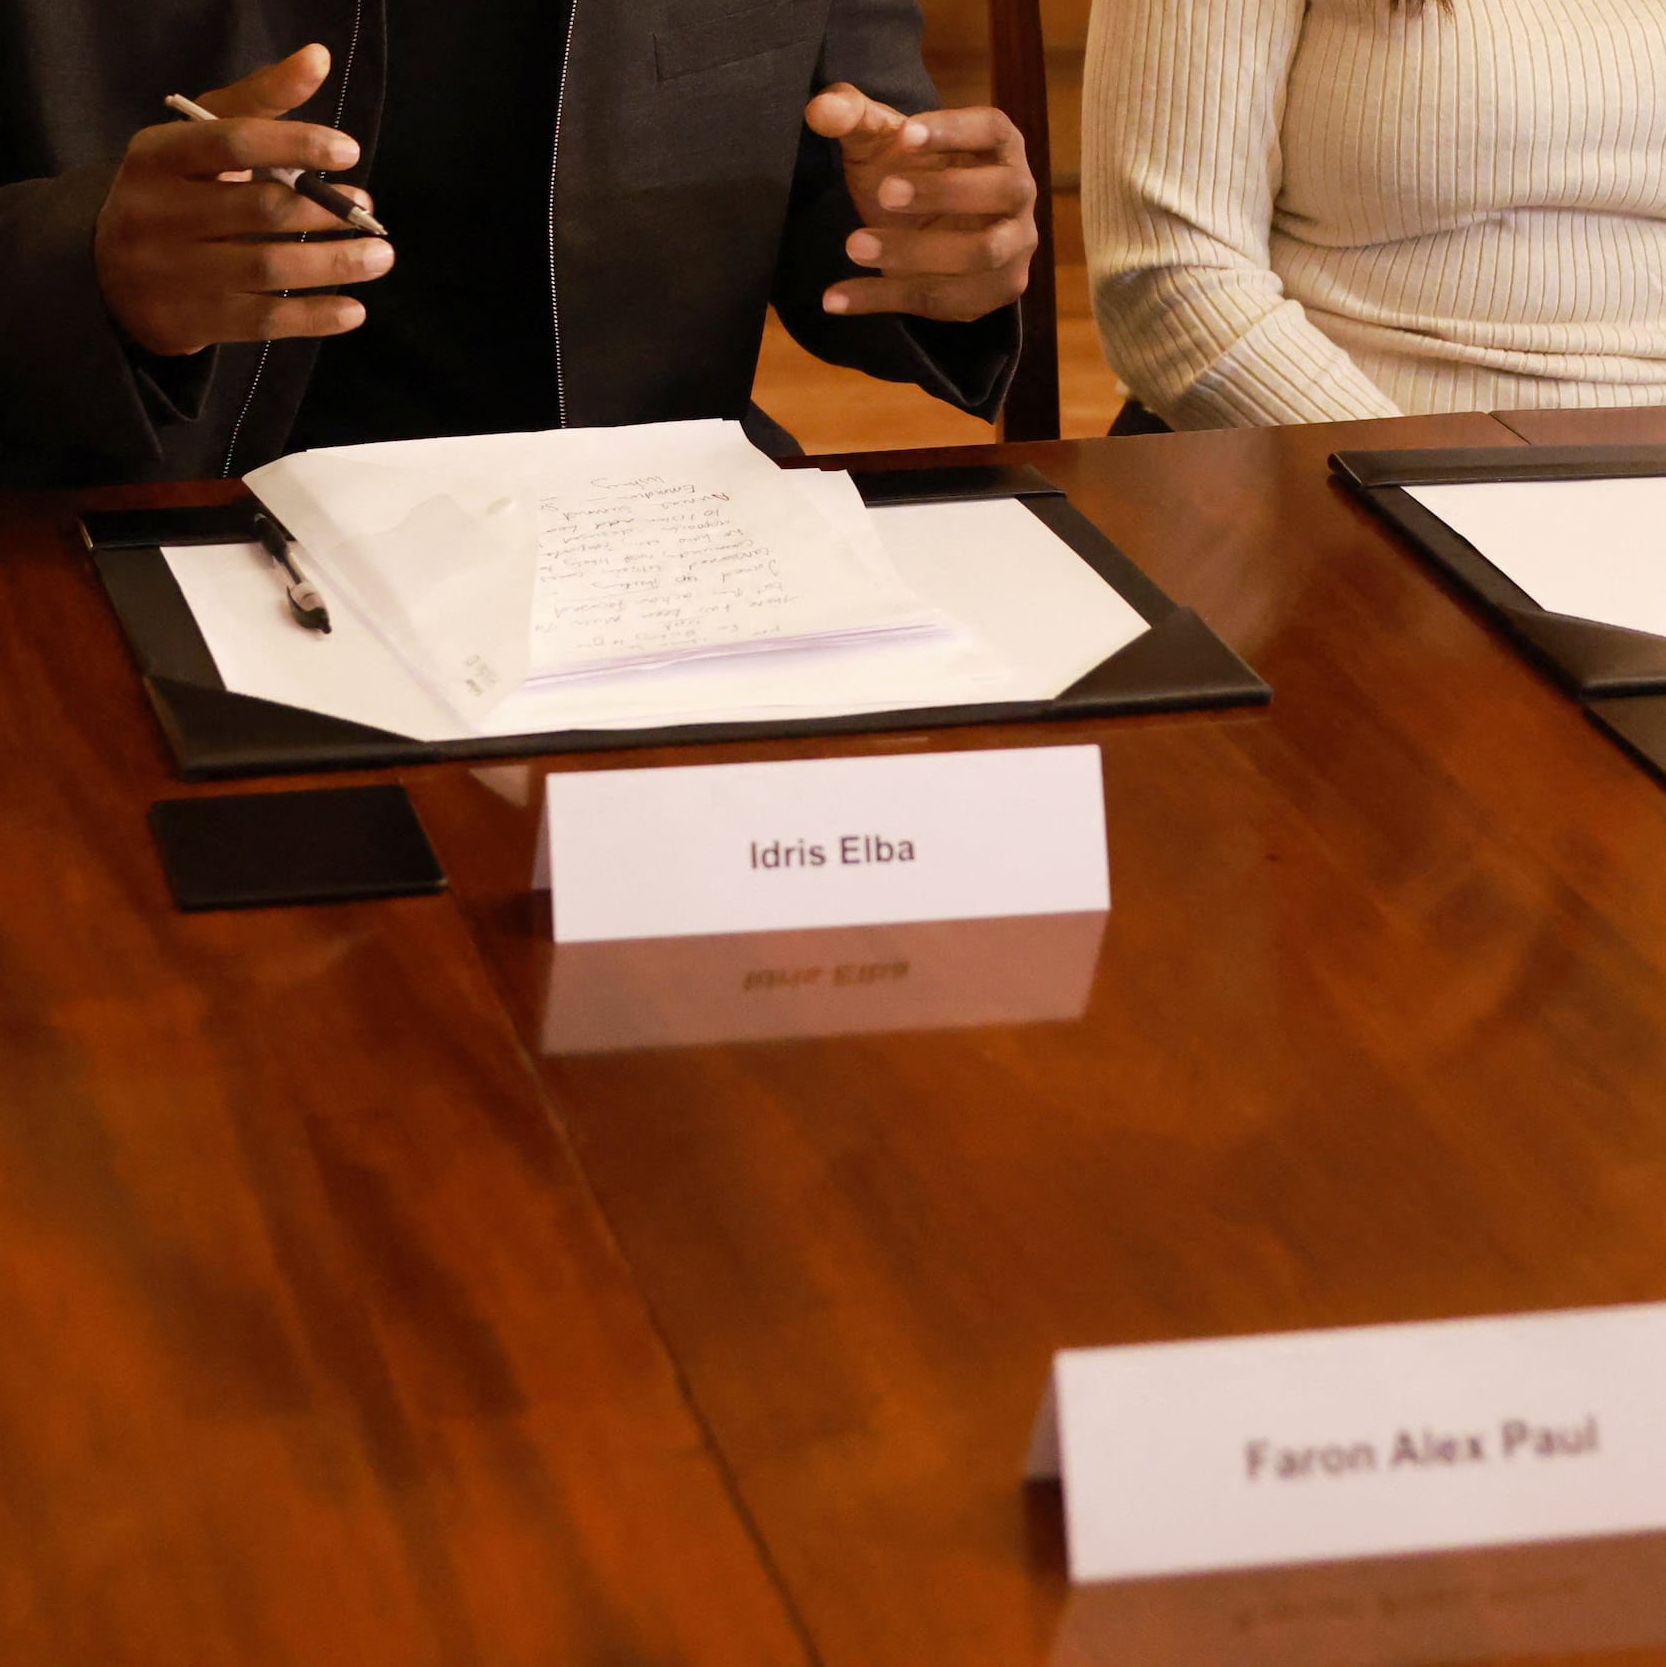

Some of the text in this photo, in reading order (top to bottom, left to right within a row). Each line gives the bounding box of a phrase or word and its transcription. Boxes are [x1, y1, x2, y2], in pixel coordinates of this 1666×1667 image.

[749, 834, 916, 871] Idris Elba
[1243, 1414, 1599, 1481] Faron Alex Paul
